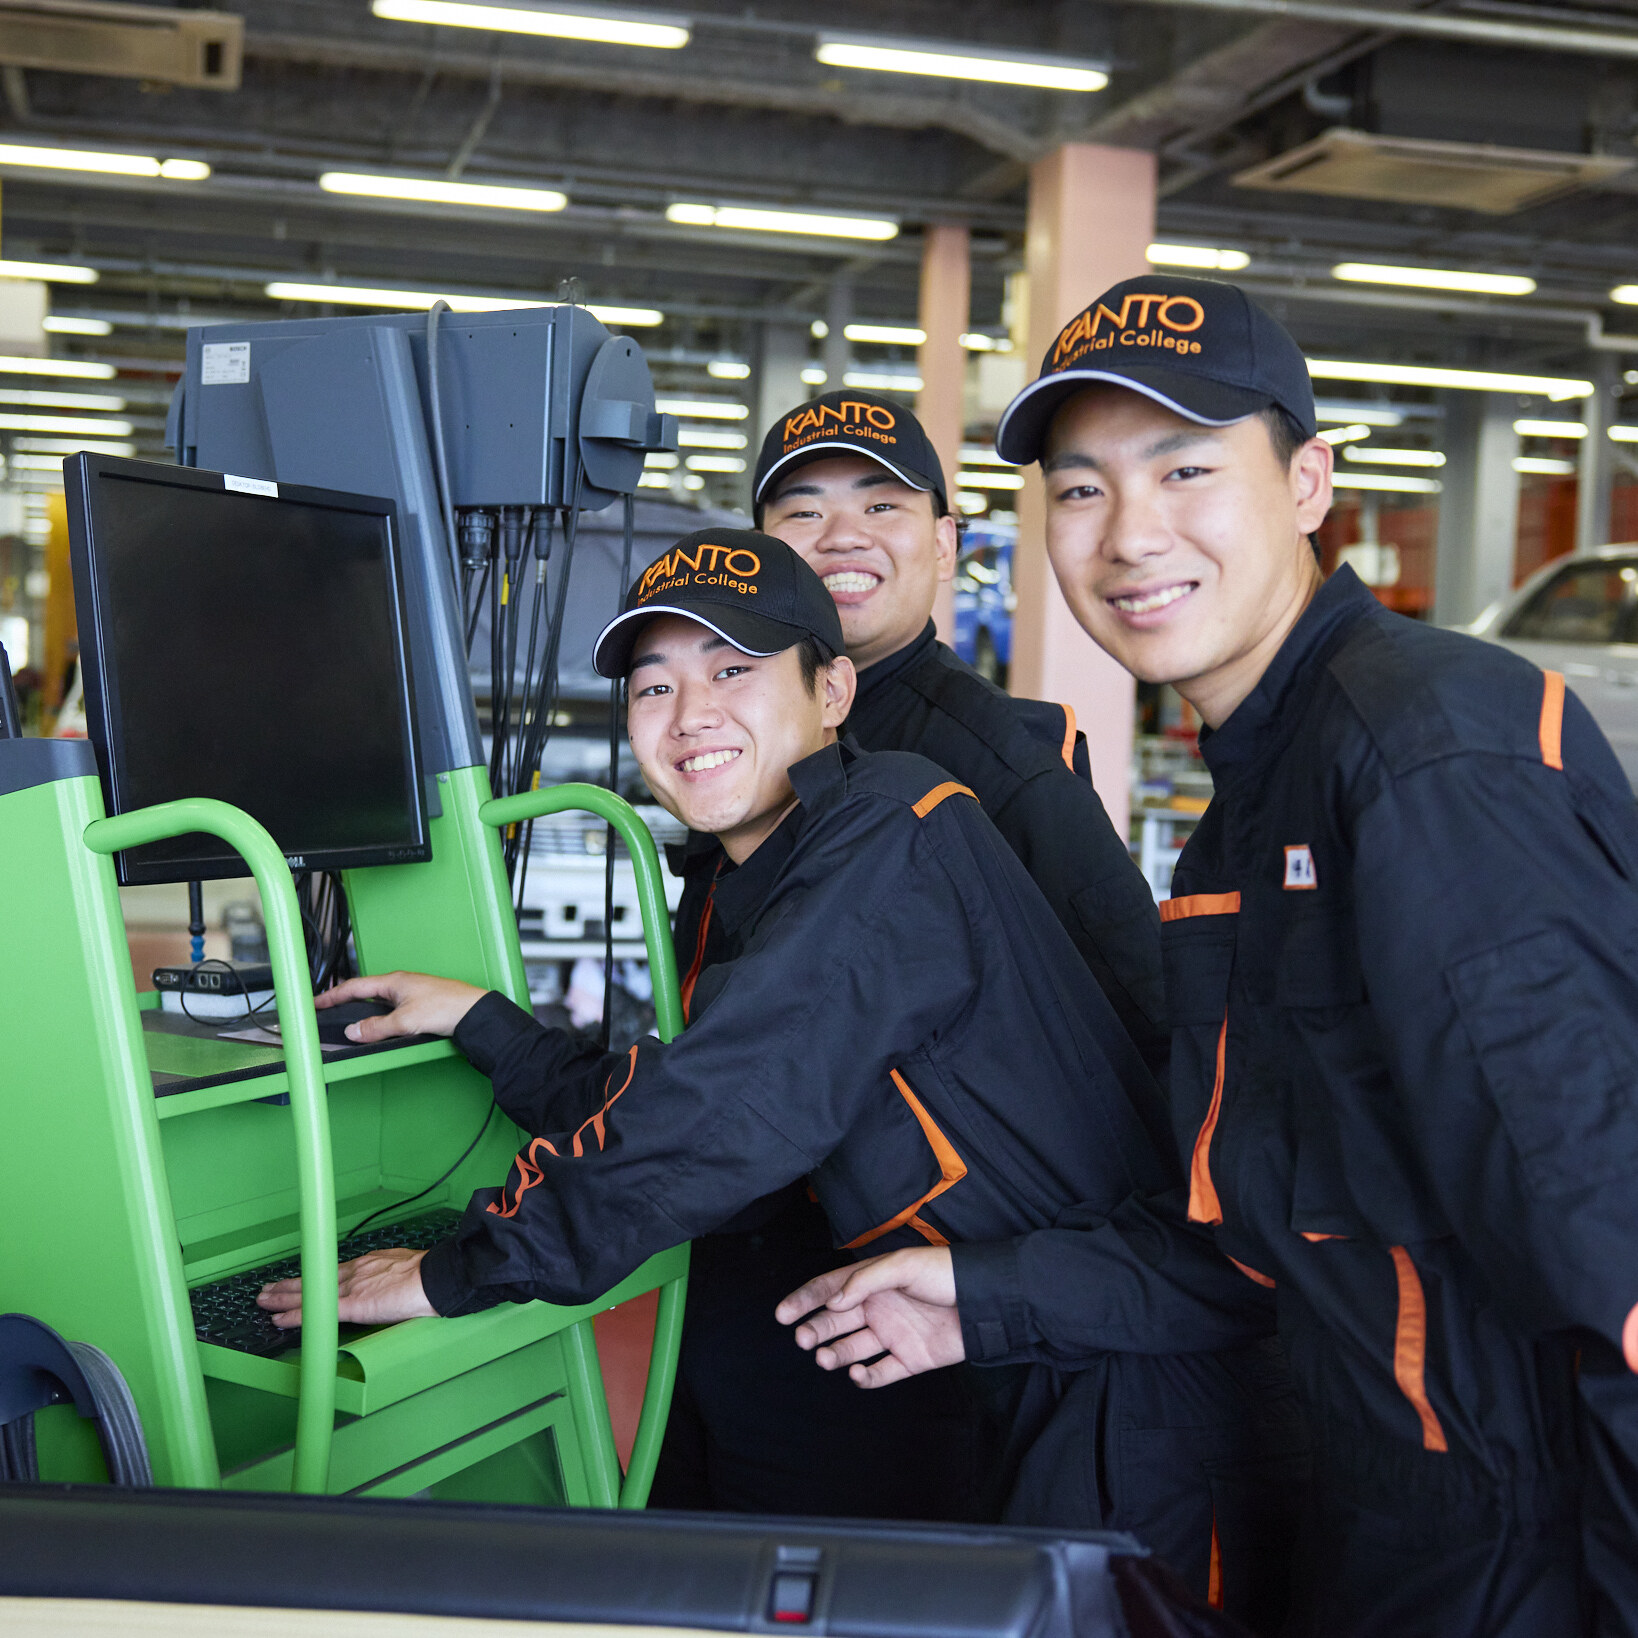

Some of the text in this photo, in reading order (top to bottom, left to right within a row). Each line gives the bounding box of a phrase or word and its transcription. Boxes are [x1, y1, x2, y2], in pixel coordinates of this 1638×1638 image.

[1052, 293, 1205, 365] KANTO
[1120, 329, 1202, 355] College
[783, 401, 896, 441] KANTO
[783, 424, 897, 454] Industrial College
[638, 544, 761, 596] KANTO
[637, 573, 758, 607] Industrial College
[285, 856, 306, 868] ELL
